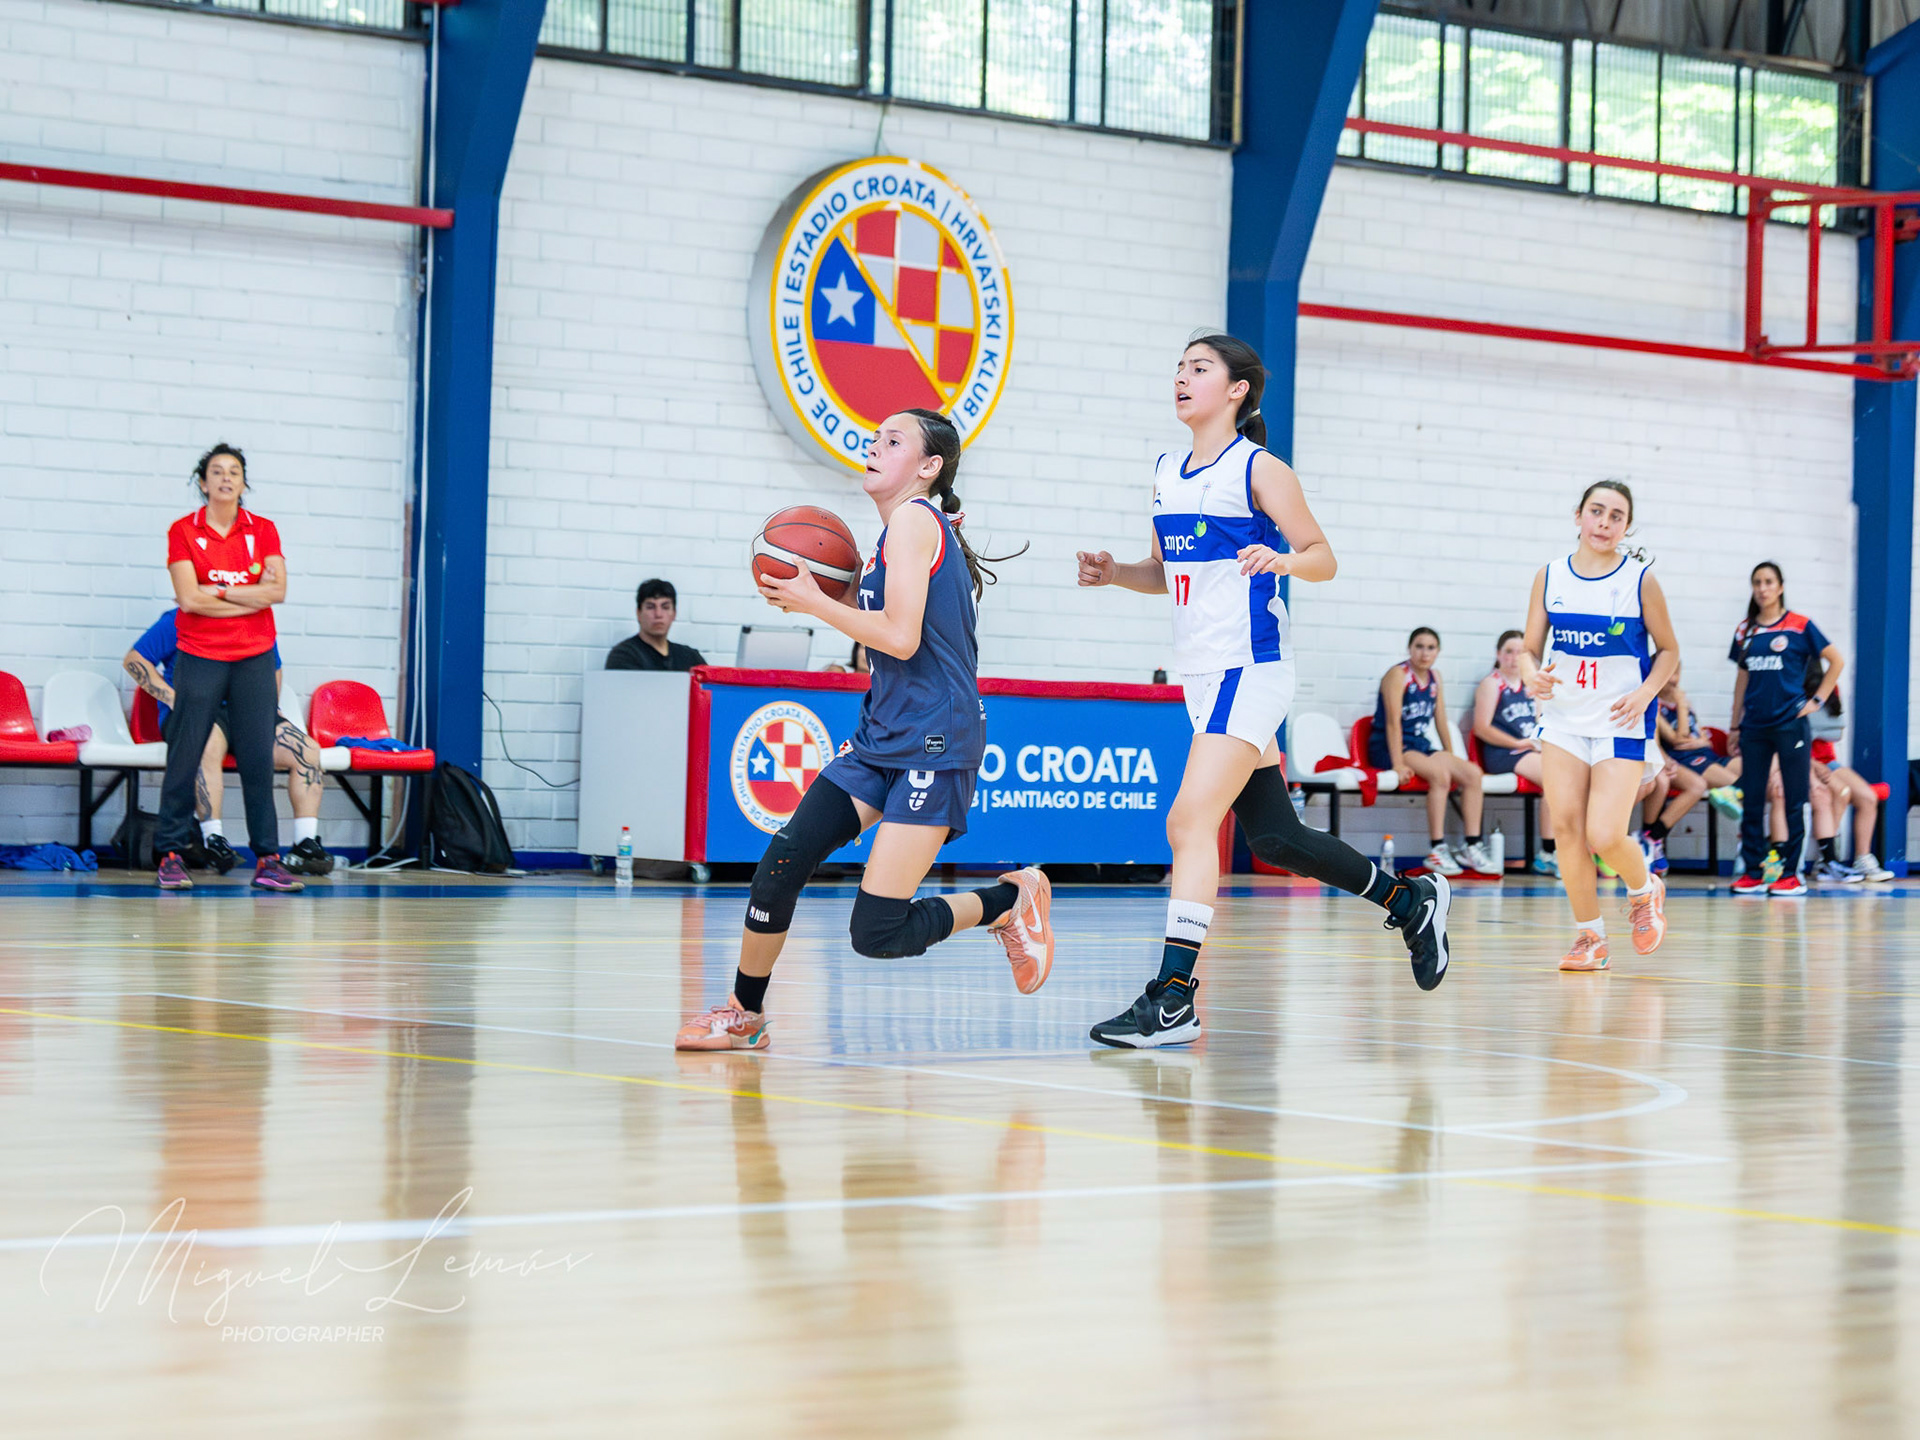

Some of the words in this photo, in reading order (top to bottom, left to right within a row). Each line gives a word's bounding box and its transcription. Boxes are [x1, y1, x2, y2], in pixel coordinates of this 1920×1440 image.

[786, 193, 847, 293] ESTADIO
[853, 175, 937, 210] CROATA
[950, 211, 1001, 339] HRVATSKI
[783, 315, 815, 395] CHILE
[964, 348, 999, 419] KLUB
[810, 398, 840, 436] DE
[1175, 574, 1190, 606] 17
[1576, 660, 1597, 689] 41
[1016, 744, 1158, 784] CROATA
[991, 789, 1080, 809] SANTIAGO
[1083, 791, 1107, 809] DE
[1110, 791, 1157, 809] CHILE
[754, 908, 770, 923] NBA
